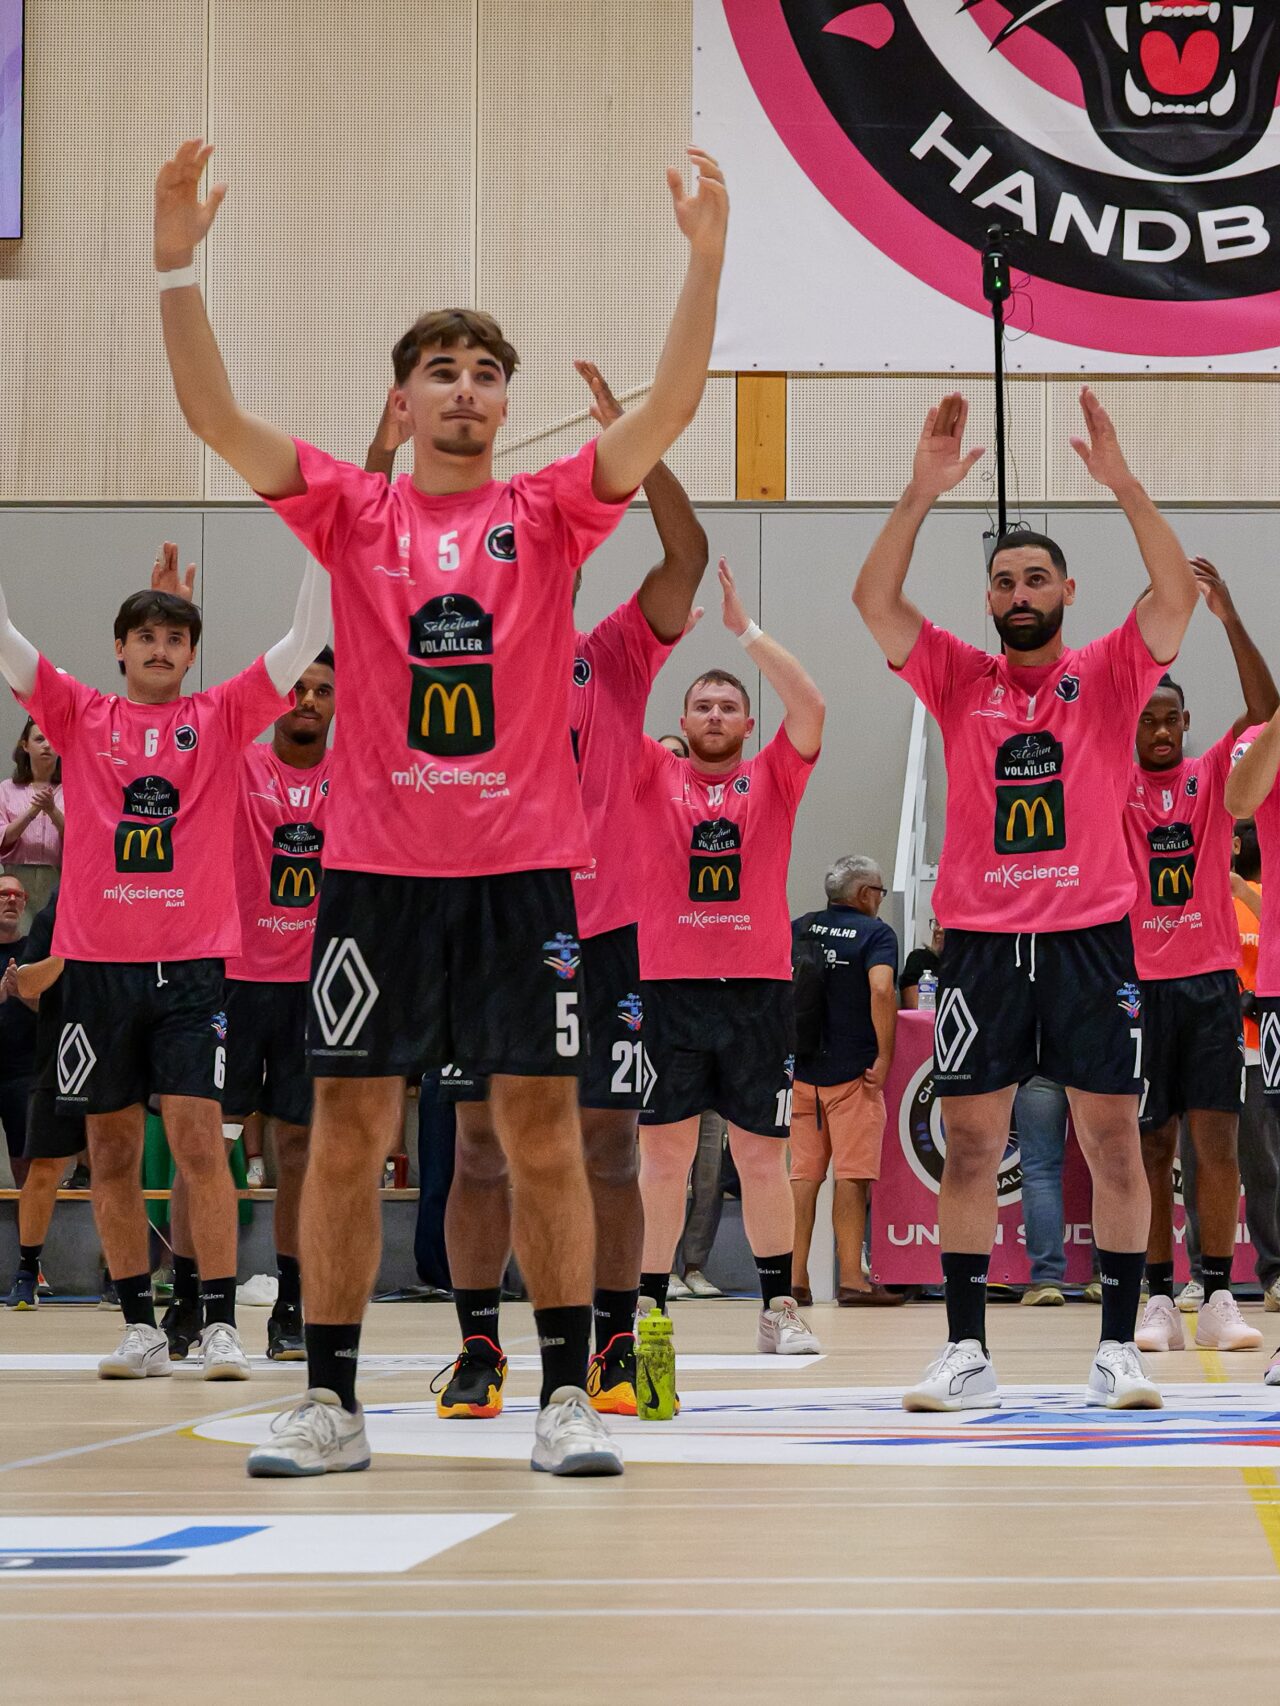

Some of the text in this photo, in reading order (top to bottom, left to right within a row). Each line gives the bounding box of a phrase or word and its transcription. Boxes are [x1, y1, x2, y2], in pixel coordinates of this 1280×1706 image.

[438, 530, 461, 572] 5
[144, 728, 160, 758] 6
[1004, 761, 1057, 777] VOLAILLER
[287, 785, 311, 808] 97
[1161, 789, 1174, 812] 8
[830, 927, 857, 939] HLHB
[555, 991, 580, 1058] 5
[213, 1045, 227, 1090] 6
[611, 1040, 644, 1093] 21
